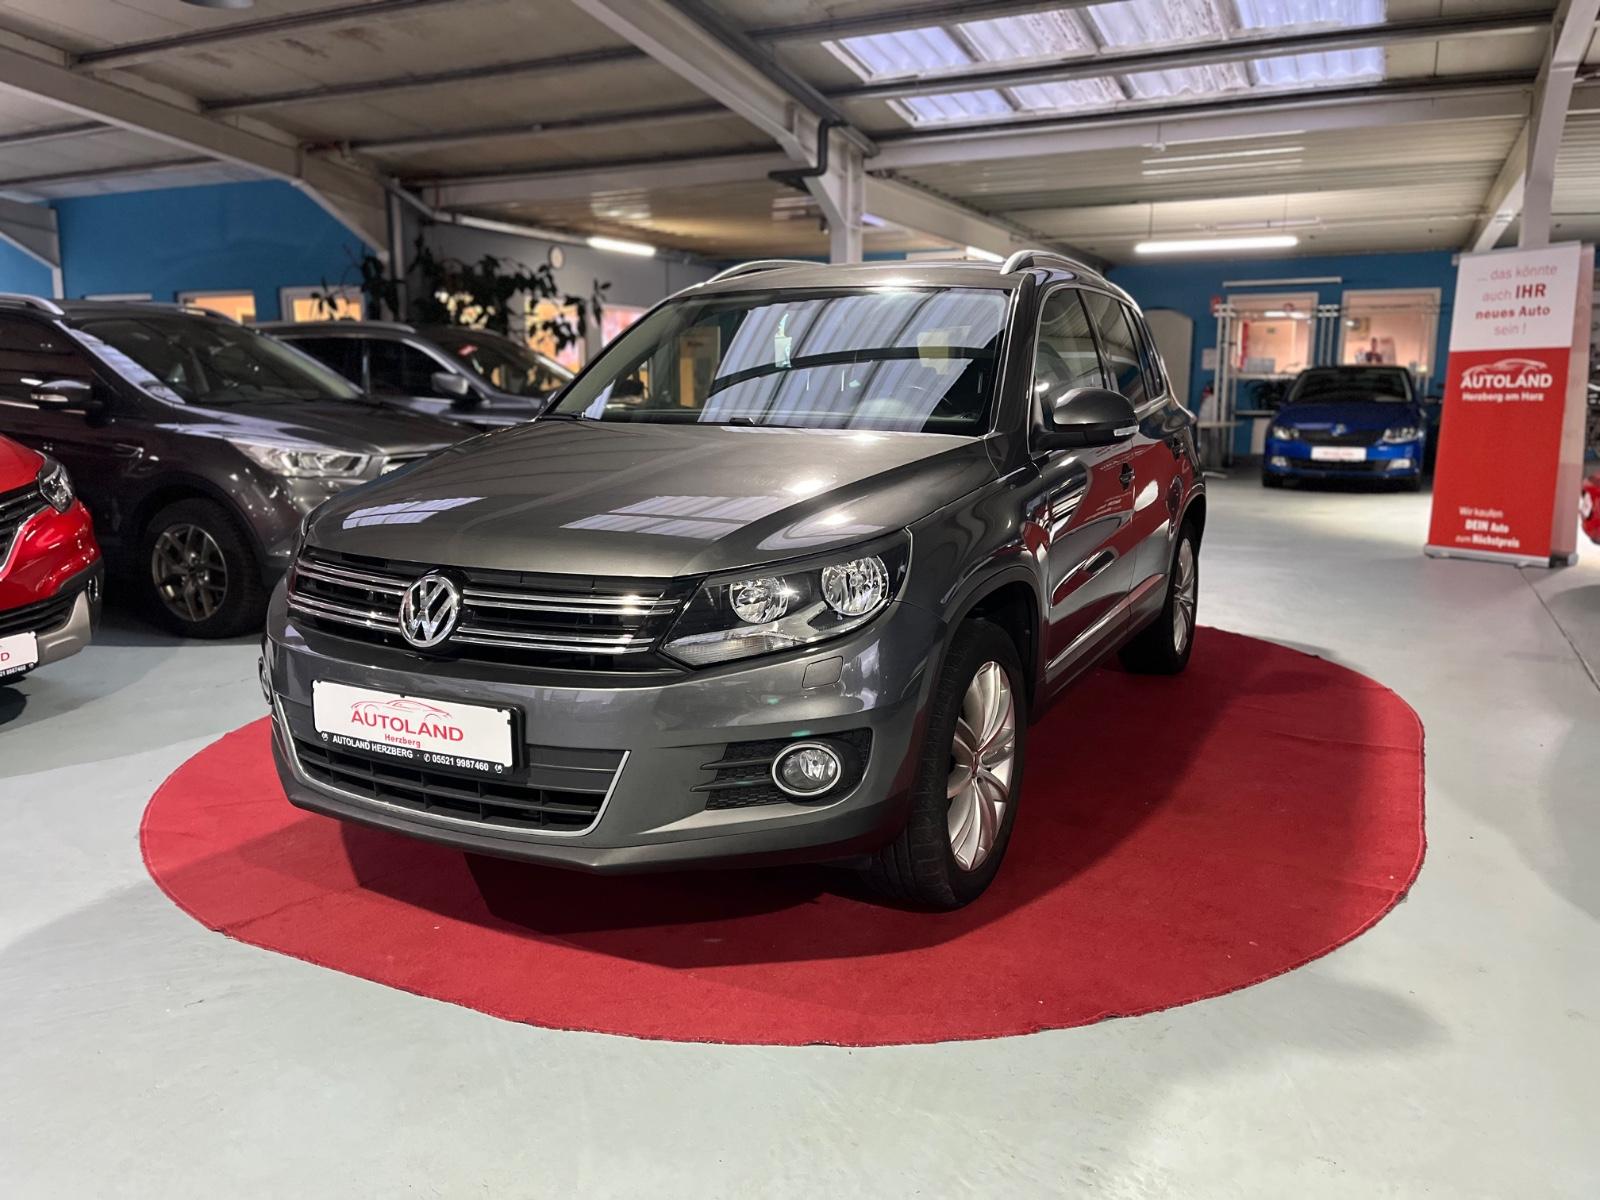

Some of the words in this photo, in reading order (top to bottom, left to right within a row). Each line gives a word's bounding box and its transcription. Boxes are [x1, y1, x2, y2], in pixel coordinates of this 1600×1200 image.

[1490, 268, 1513, 280] das
[1515, 264, 1558, 279] könnte
[1482, 289, 1512, 302] auch
[1515, 283, 1547, 299] IHR
[1475, 308, 1514, 320] neues
[1518, 304, 1551, 317] Auto
[1493, 324, 1519, 336] sein
[1460, 373, 1553, 389] AUTOLAND
[1462, 391, 1503, 403] Herzberg
[1505, 393, 1520, 401] am
[1521, 391, 1545, 402] Harz
[1465, 519, 1489, 532] DEIN
[1490, 521, 1510, 534] Auto
[351, 710, 464, 743] AUTOLAND
[384, 732, 421, 749] Herzberg
[332, 735, 371, 751] AUTOLAND
[371, 743, 413, 759] HERZBERG
[432, 754, 454, 767] 05521
[456, 757, 489, 772] 9987460
